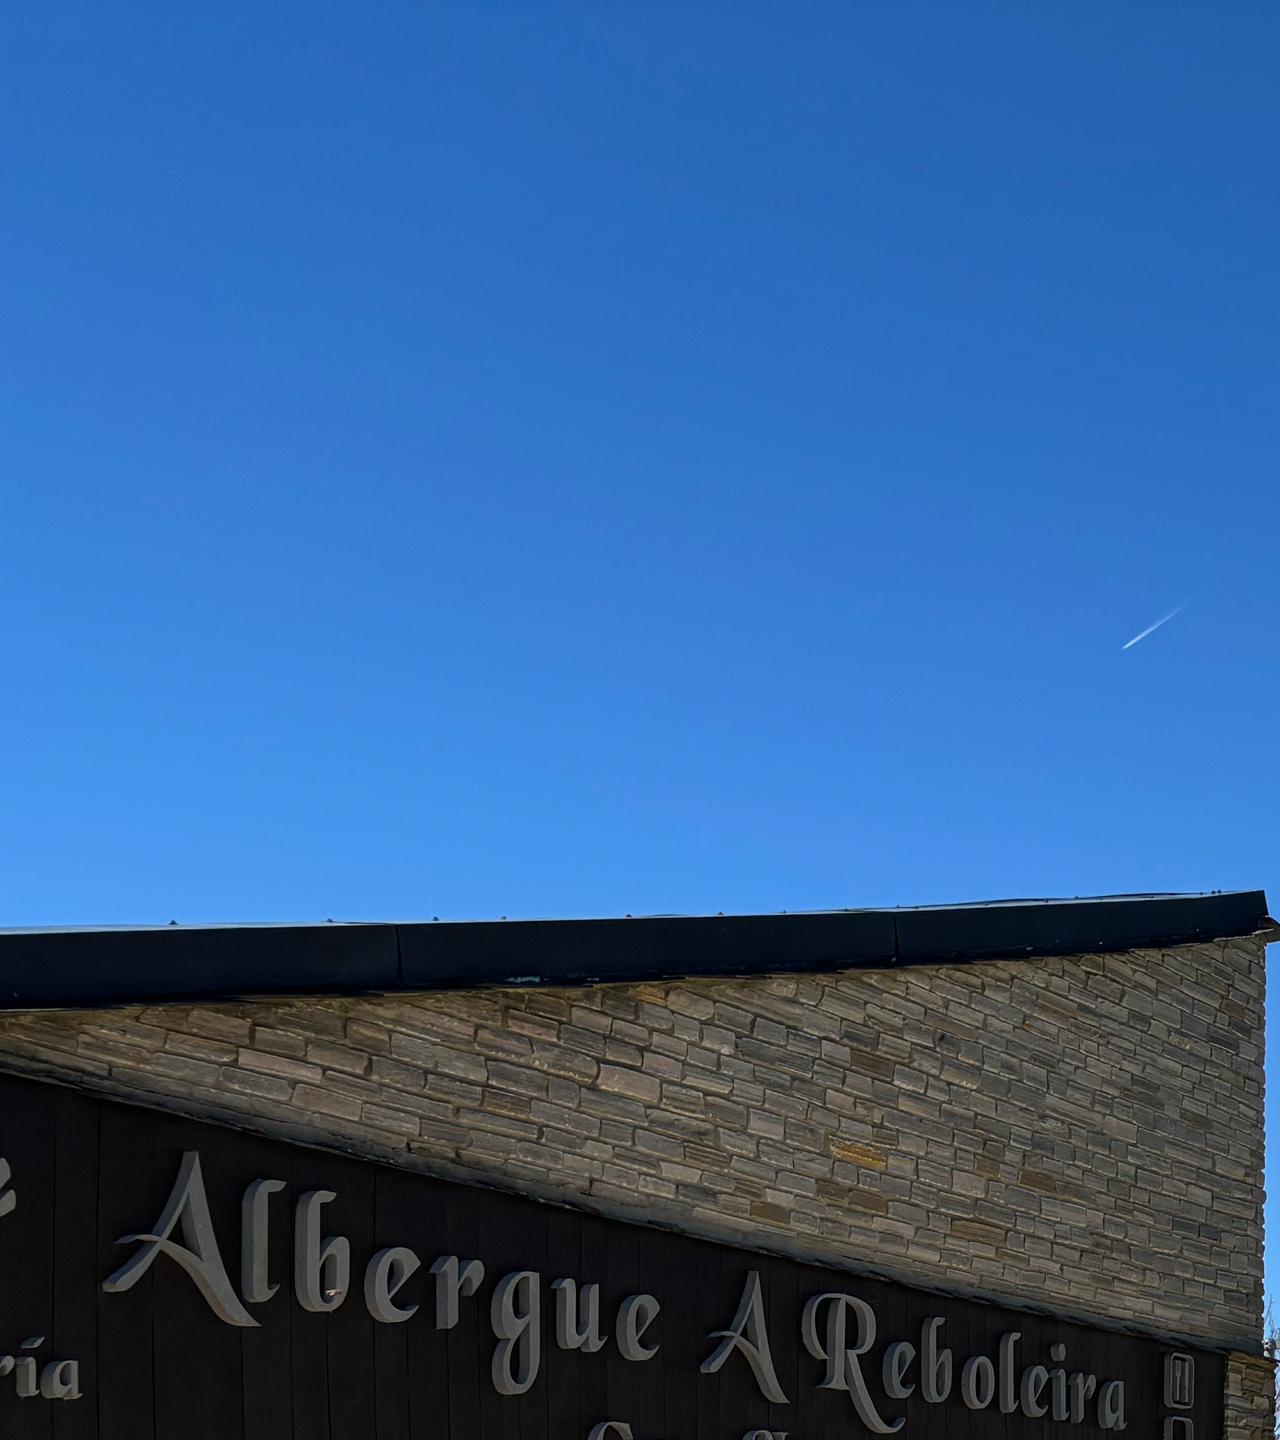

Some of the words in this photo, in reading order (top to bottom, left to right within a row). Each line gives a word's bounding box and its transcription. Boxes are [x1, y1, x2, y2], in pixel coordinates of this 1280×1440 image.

[102, 1151, 661, 1395] Albergue
[700, 1270, 790, 1404] A
[801, 1292, 1127, 1434] Reboleira
